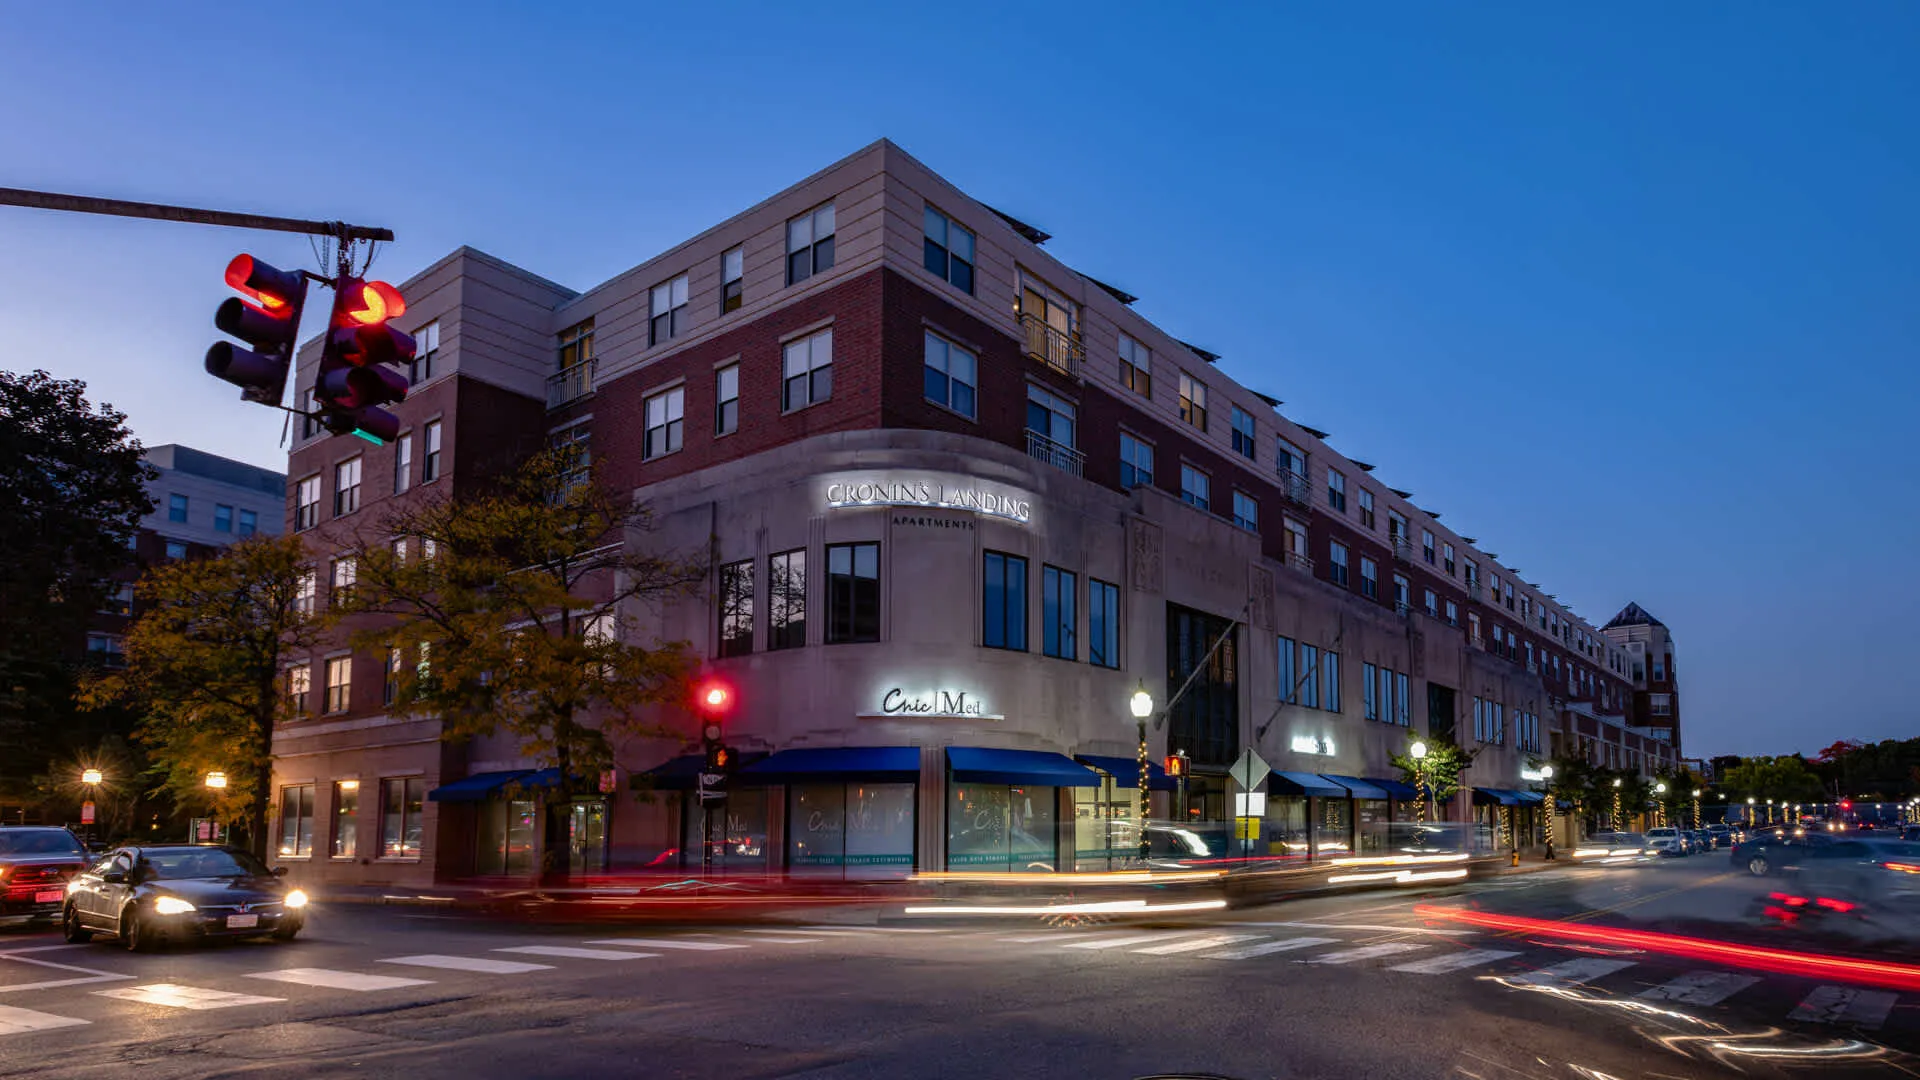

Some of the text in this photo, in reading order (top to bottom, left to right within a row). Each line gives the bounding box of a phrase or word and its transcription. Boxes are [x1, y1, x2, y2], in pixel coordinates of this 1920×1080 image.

[938, 484, 1030, 521] LANDING
[893, 515, 976, 531] APARTMENTS
[883, 687, 981, 714] Chic Med
